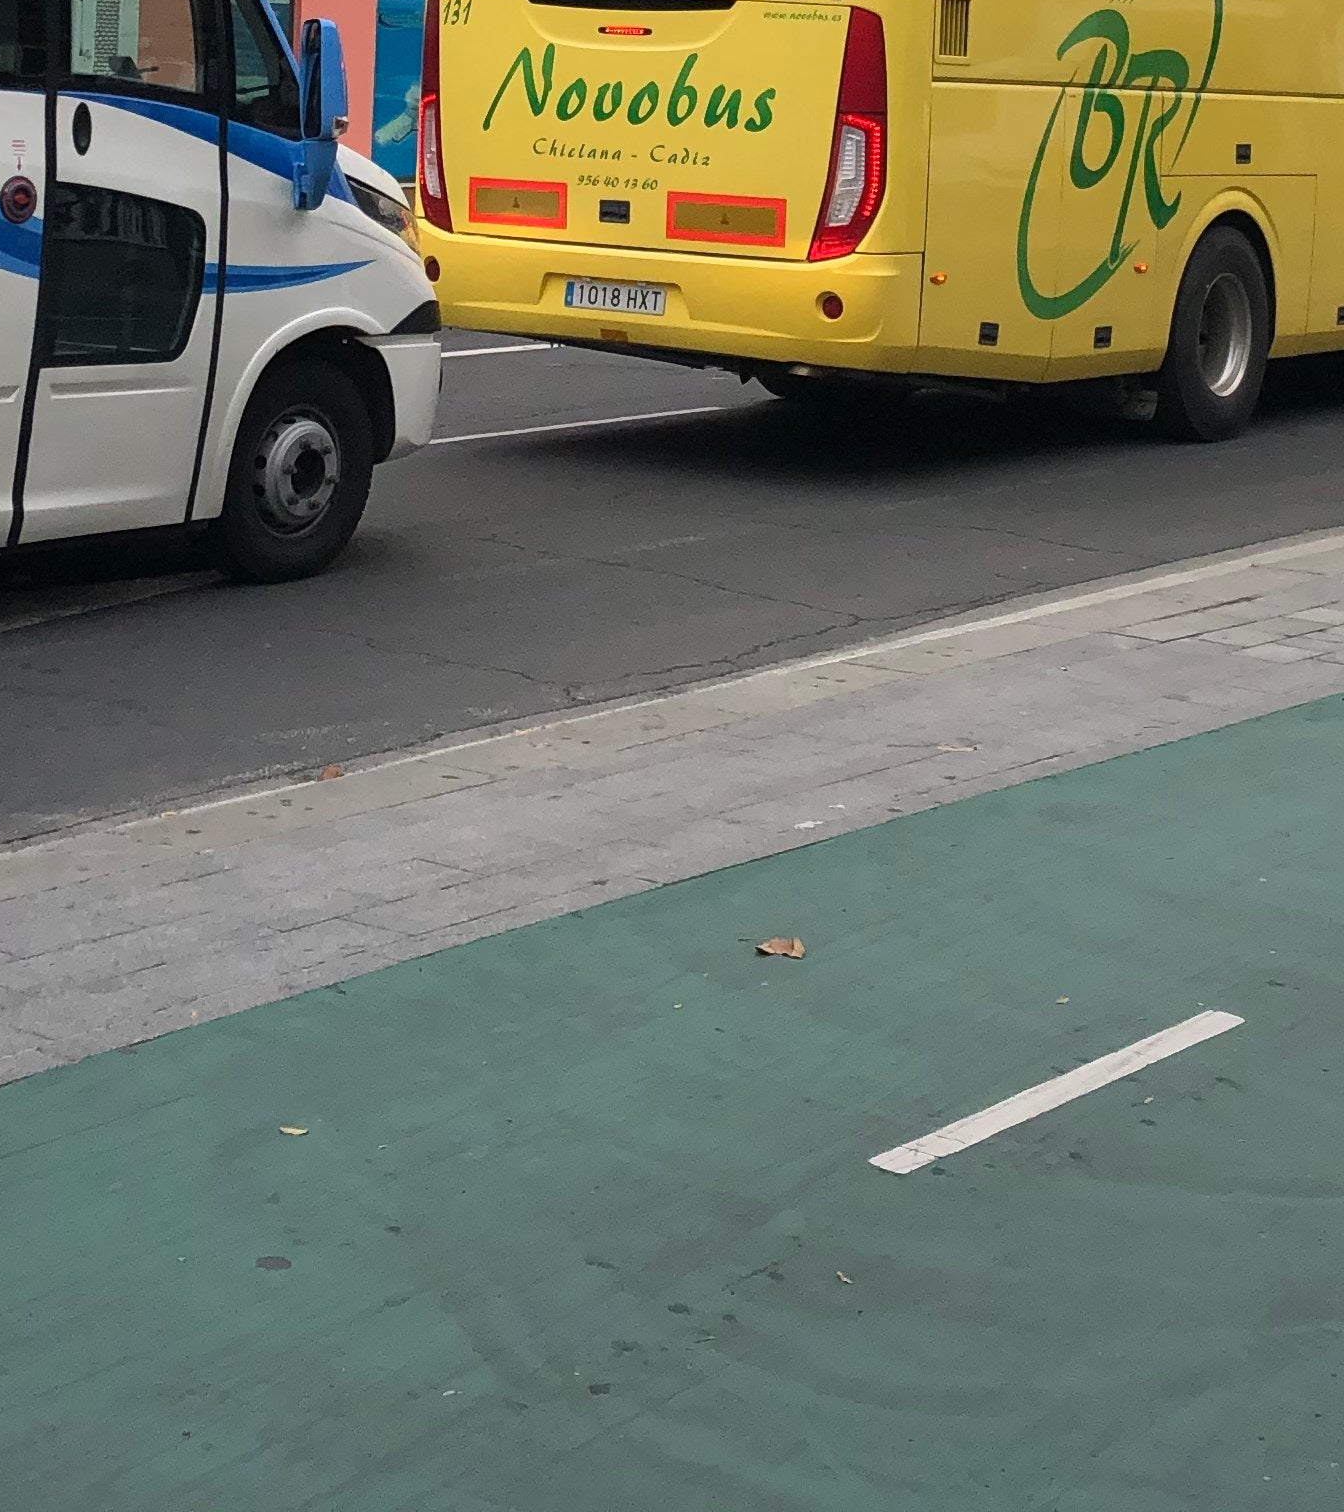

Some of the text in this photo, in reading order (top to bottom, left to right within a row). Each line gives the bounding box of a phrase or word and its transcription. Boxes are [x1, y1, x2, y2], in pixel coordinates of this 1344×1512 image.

[482, 42, 777, 133] Novobus
[532, 137, 622, 162] Chiclana
[649, 144, 712, 167] Cadiz
[576, 174, 659, 191] 956 40 13 60
[578, 284, 662, 312] 1018 HXT
